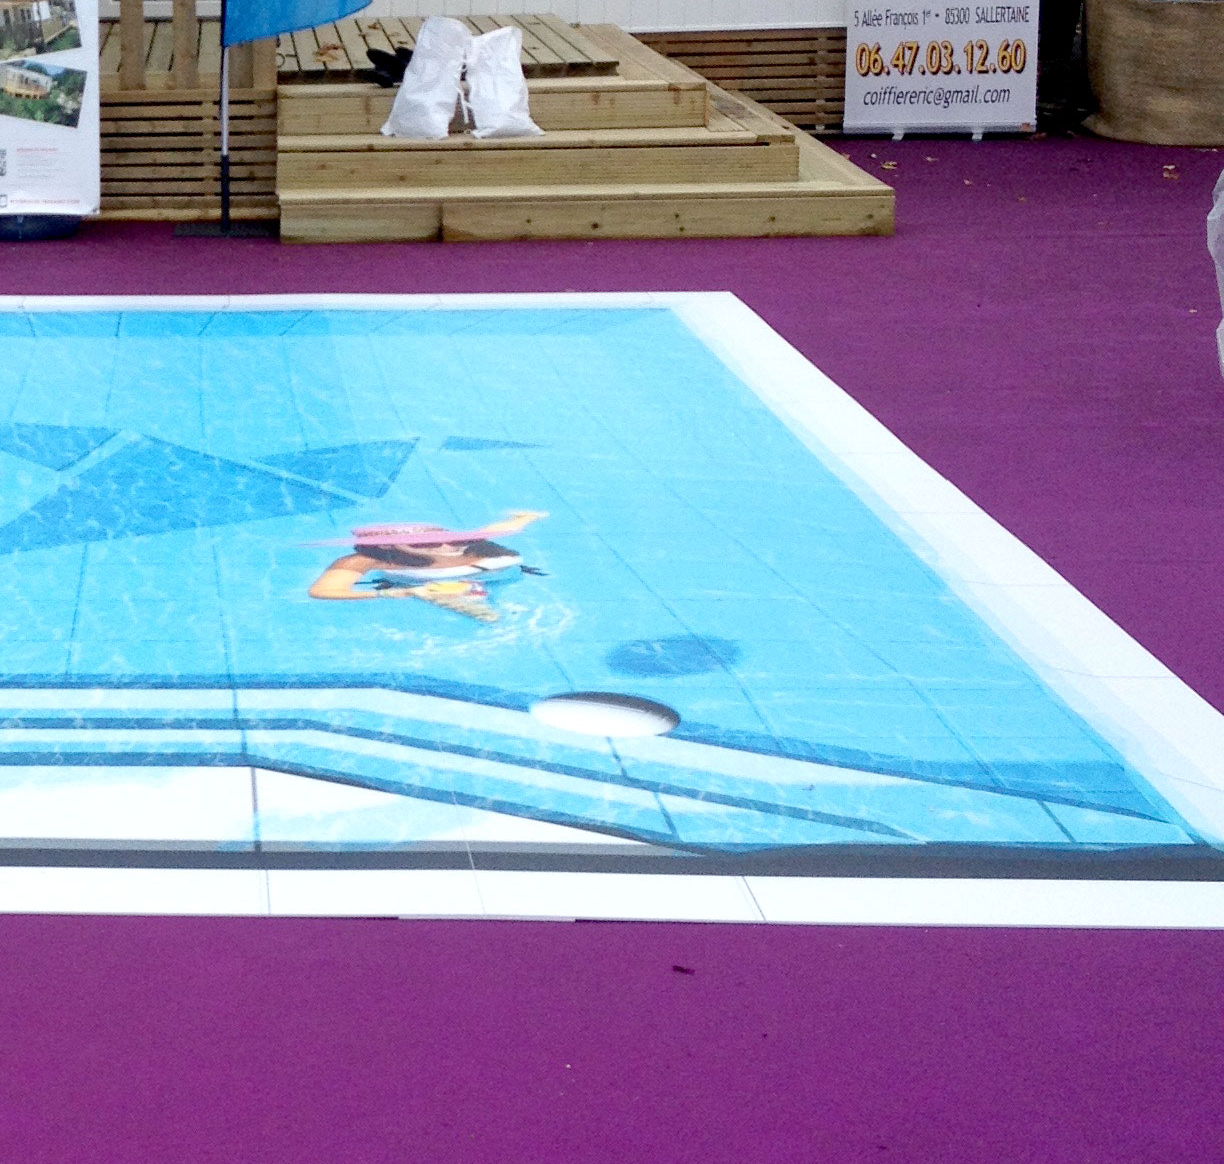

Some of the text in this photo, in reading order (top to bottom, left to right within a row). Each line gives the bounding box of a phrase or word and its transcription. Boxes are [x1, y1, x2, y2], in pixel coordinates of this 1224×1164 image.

[854, 10, 860, 28] 5
[861, 7, 883, 27] Allée
[885, 8, 919, 30] François
[945, 6, 970, 25] 85300
[975, 5, 1030, 25] SALLERTAINE
[855, 38, 1027, 77] 06.47.03.12.60
[862, 84, 1011, 109] coiffiereric@gmail.com
